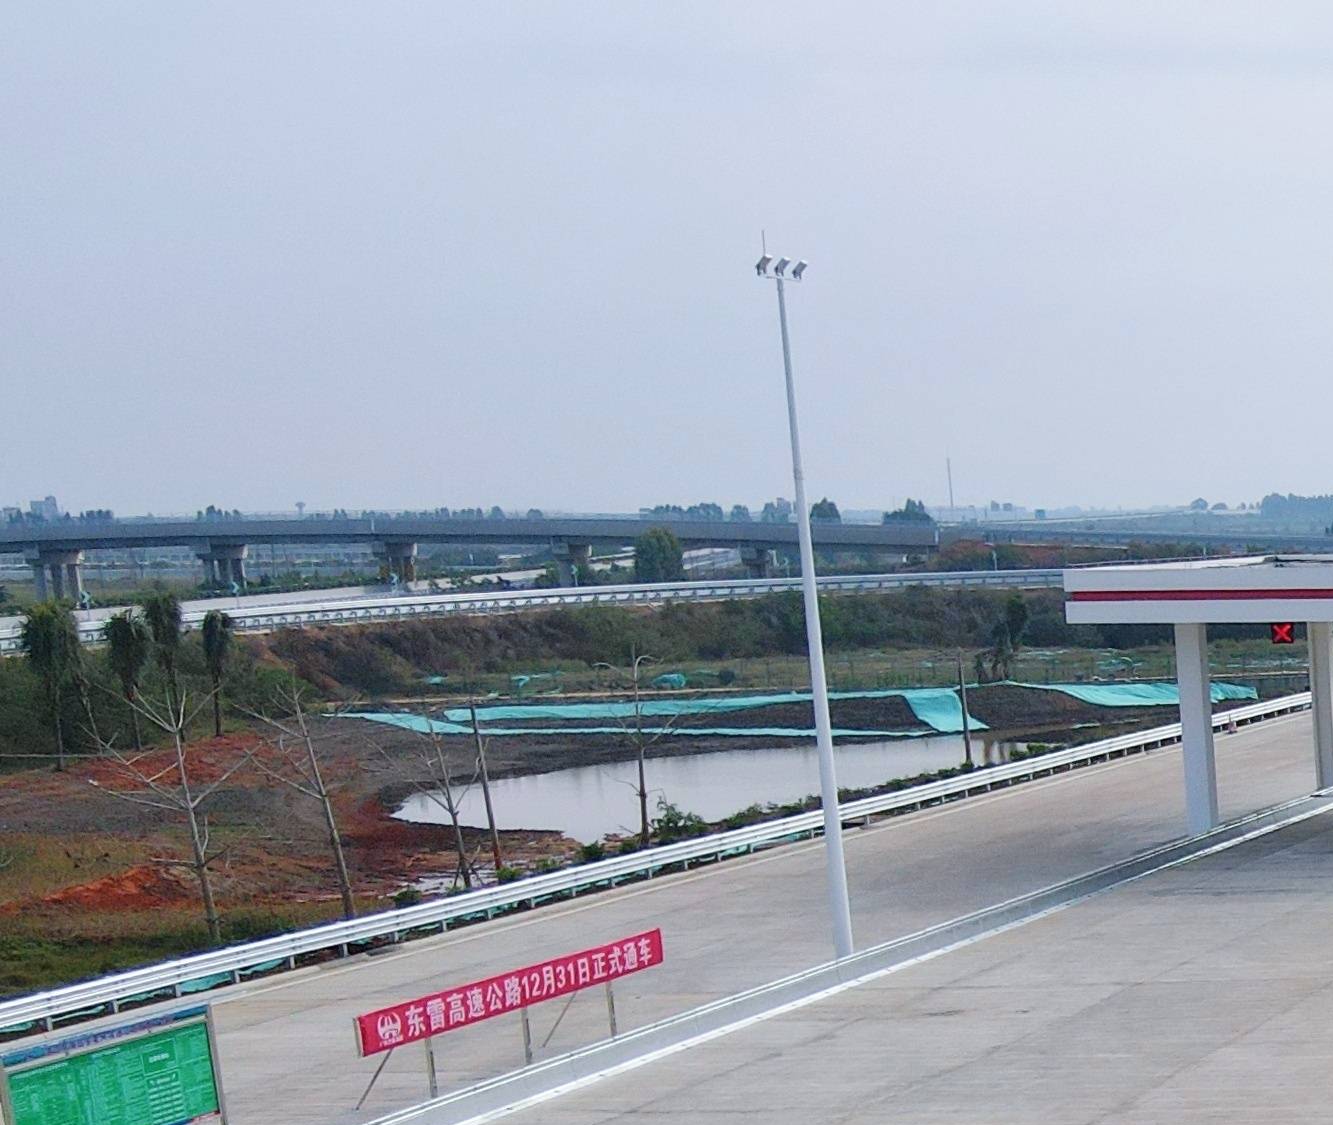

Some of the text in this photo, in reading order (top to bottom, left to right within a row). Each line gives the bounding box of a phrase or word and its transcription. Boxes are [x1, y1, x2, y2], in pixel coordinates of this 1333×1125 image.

[404, 936, 653, 1038] 东雷高速公路12月31日正式通车
